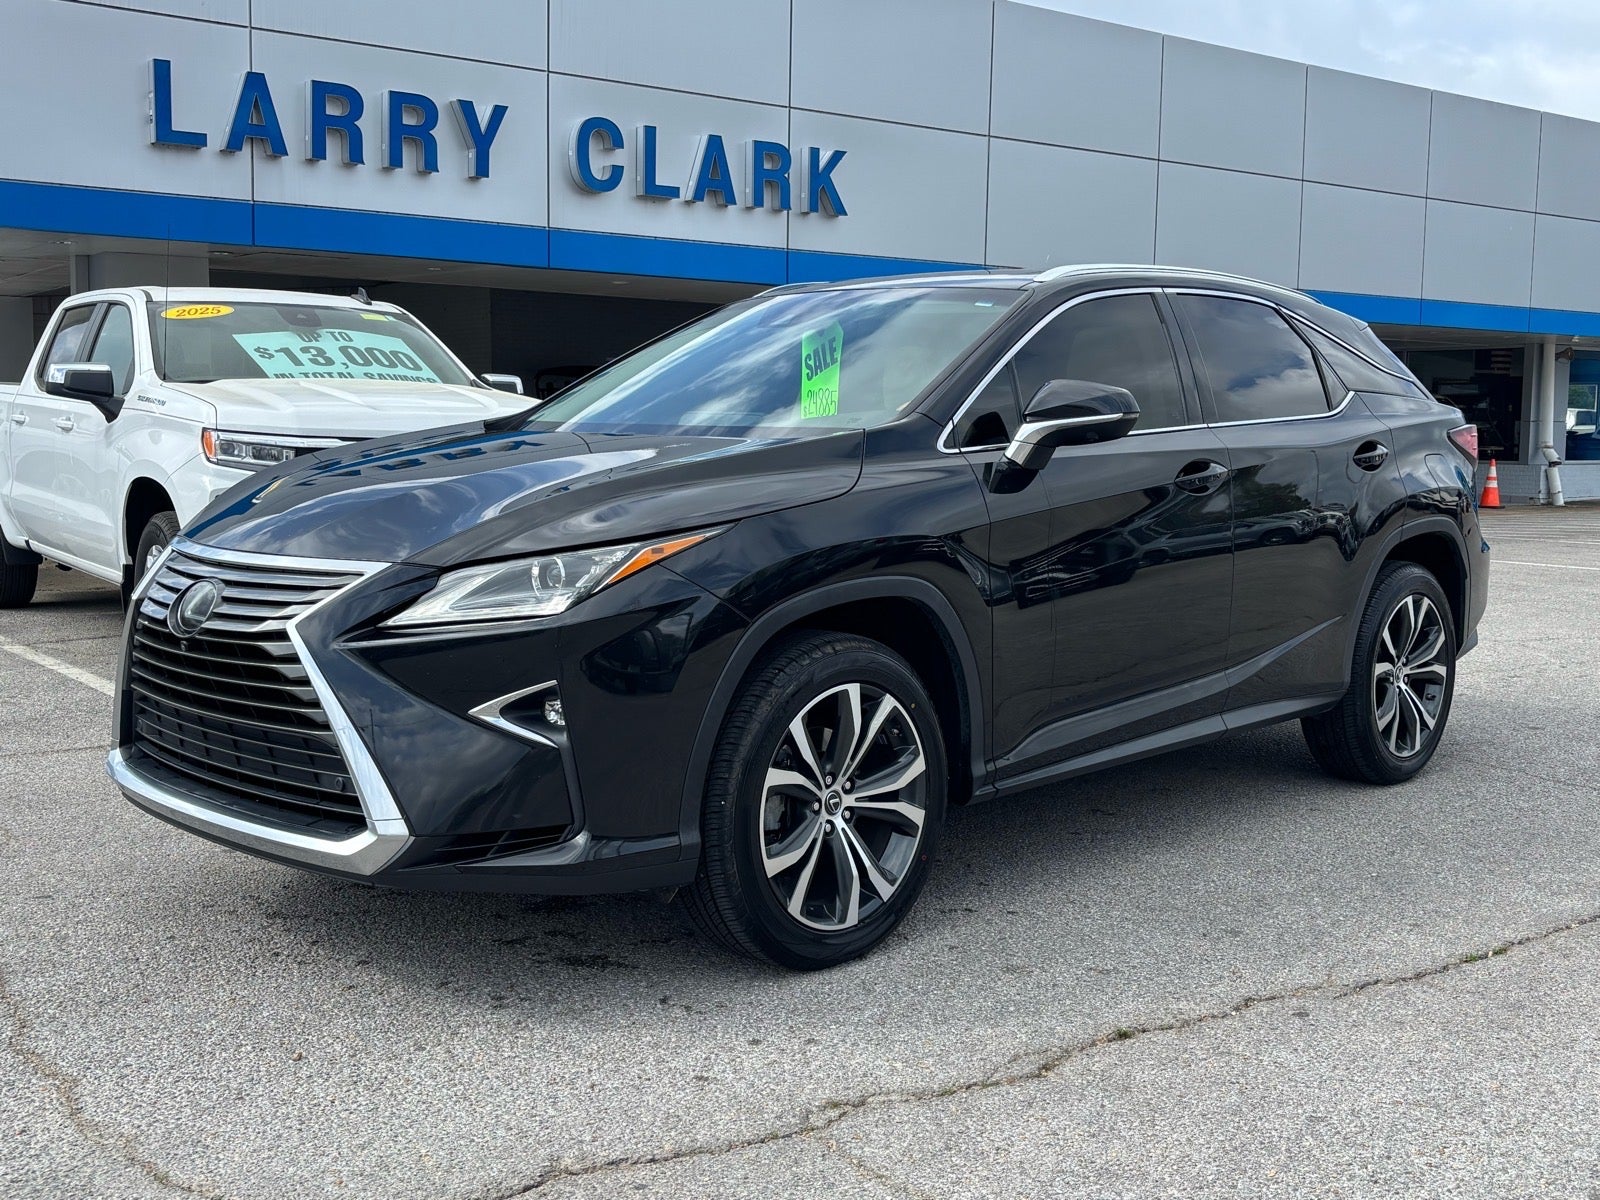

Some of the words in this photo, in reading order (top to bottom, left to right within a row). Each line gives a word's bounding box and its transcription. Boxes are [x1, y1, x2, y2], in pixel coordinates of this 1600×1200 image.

[149, 58, 508, 178] LARRY
[568, 116, 848, 216] CLARK
[175, 306, 221, 317] 2025
[295, 331, 322, 342] UP
[325, 331, 354, 342] TO
[253, 345, 423, 372] $13,000
[804, 336, 839, 381] SALE
